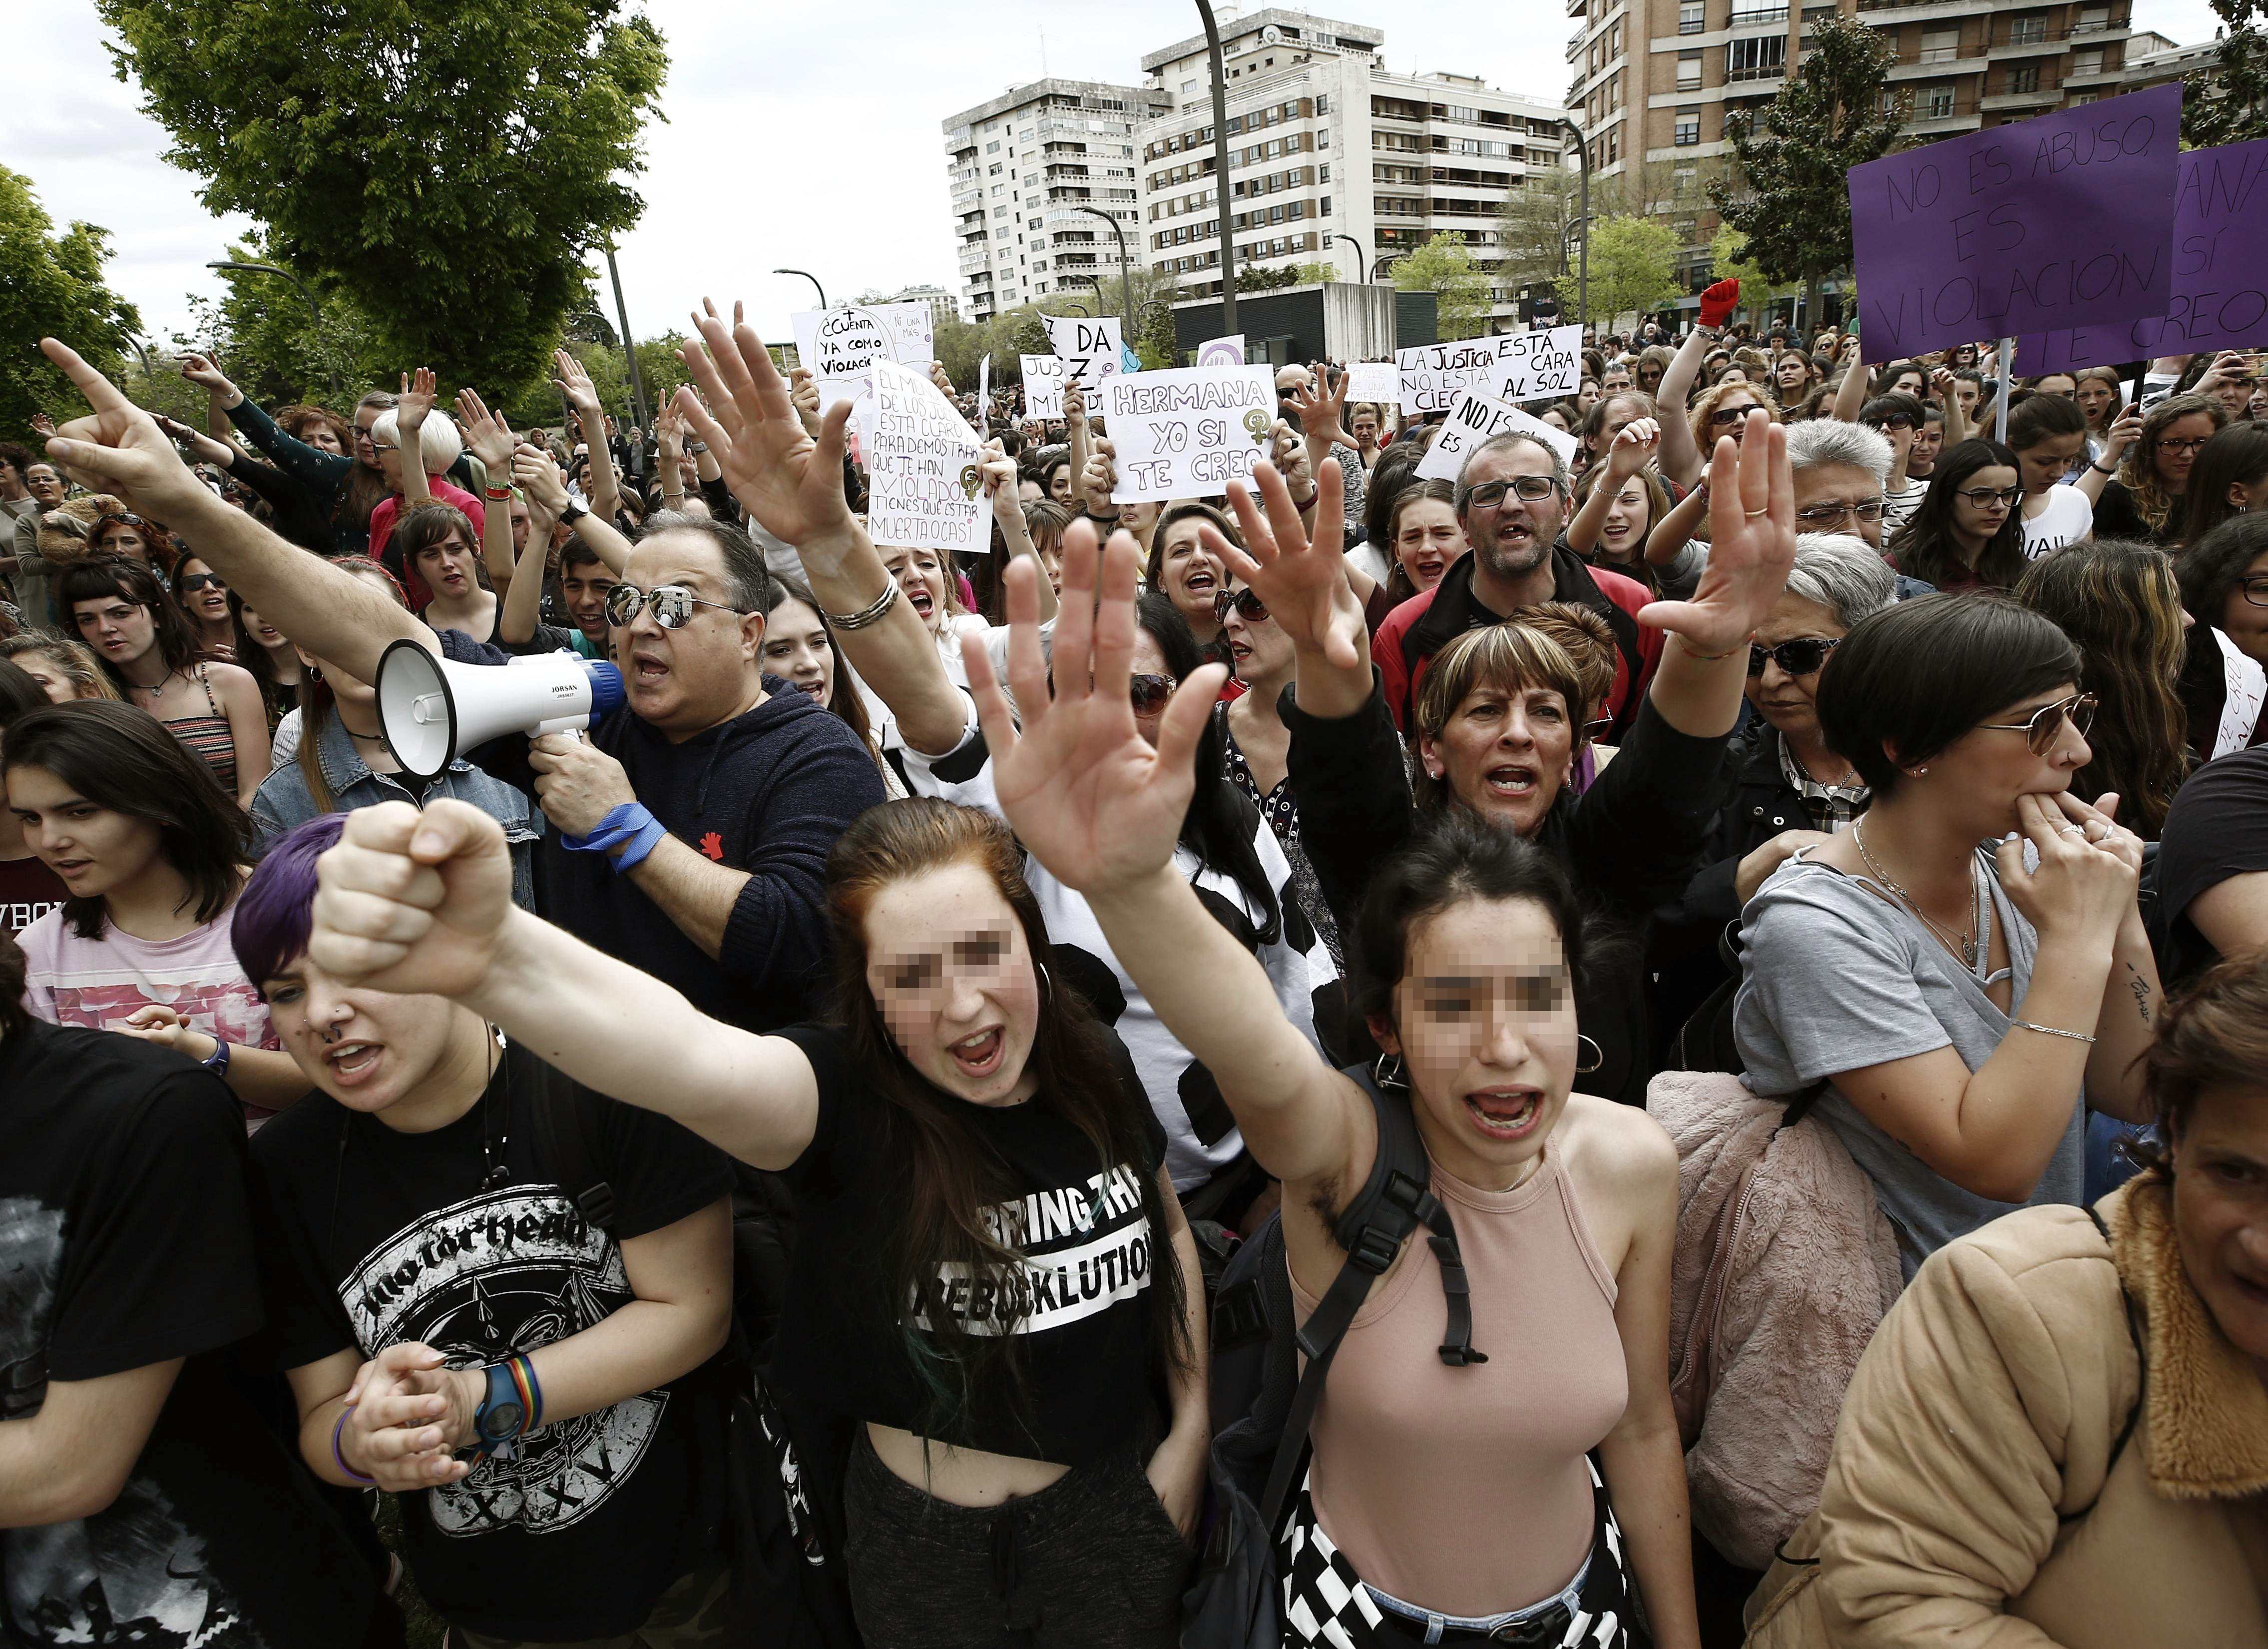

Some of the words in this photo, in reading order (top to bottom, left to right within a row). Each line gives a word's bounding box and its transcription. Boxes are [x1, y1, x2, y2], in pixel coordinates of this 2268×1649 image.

[1887, 164, 1941, 221] NO
[1969, 145, 2012, 195] ES
[1950, 202, 2026, 263] ES
[2177, 226, 2227, 276] SÍ
[1875, 244, 2159, 346] VIOLACIÓN
[907, 317, 920, 326] UNA
[820, 342, 841, 355] YA
[848, 338, 882, 350] COMO
[1498, 330, 1554, 358] ESTÁ
[1400, 351, 1427, 371] LA
[1531, 351, 1574, 371] CARA
[880, 369, 898, 390] EL
[1368, 383, 1386, 391] UNA
[1401, 374, 1431, 392] NO
[1443, 366, 1491, 388] ESTÁ
[1502, 377, 1526, 398] AL
[1534, 371, 1572, 393] SOL
[881, 393, 899, 412] DE
[905, 396, 926, 417] LOS
[1114, 381, 1267, 416] HERMANA
[881, 413, 915, 433] ESTA
[1456, 396, 1488, 430] NO
[1486, 410, 1513, 436] ES
[874, 432, 904, 454] PARA
[1149, 422, 1188, 454] YO
[1197, 419, 1226, 447] SI
[1439, 431, 1462, 453] ES
[872, 452, 894, 474] QUE
[897, 456, 913, 475] TE
[918, 459, 943, 477] HAN
[1129, 460, 1172, 491] TE
[1191, 449, 1263, 482] CREO
[871, 495, 919, 512] TIENES
[922, 499, 941, 515] QUE
[945, 503, 978, 519] ESTAR
[871, 517, 927, 541] MUERTA
[551, 684, 577, 693] JORSAN
[976, 1187, 1094, 1248] BRING
